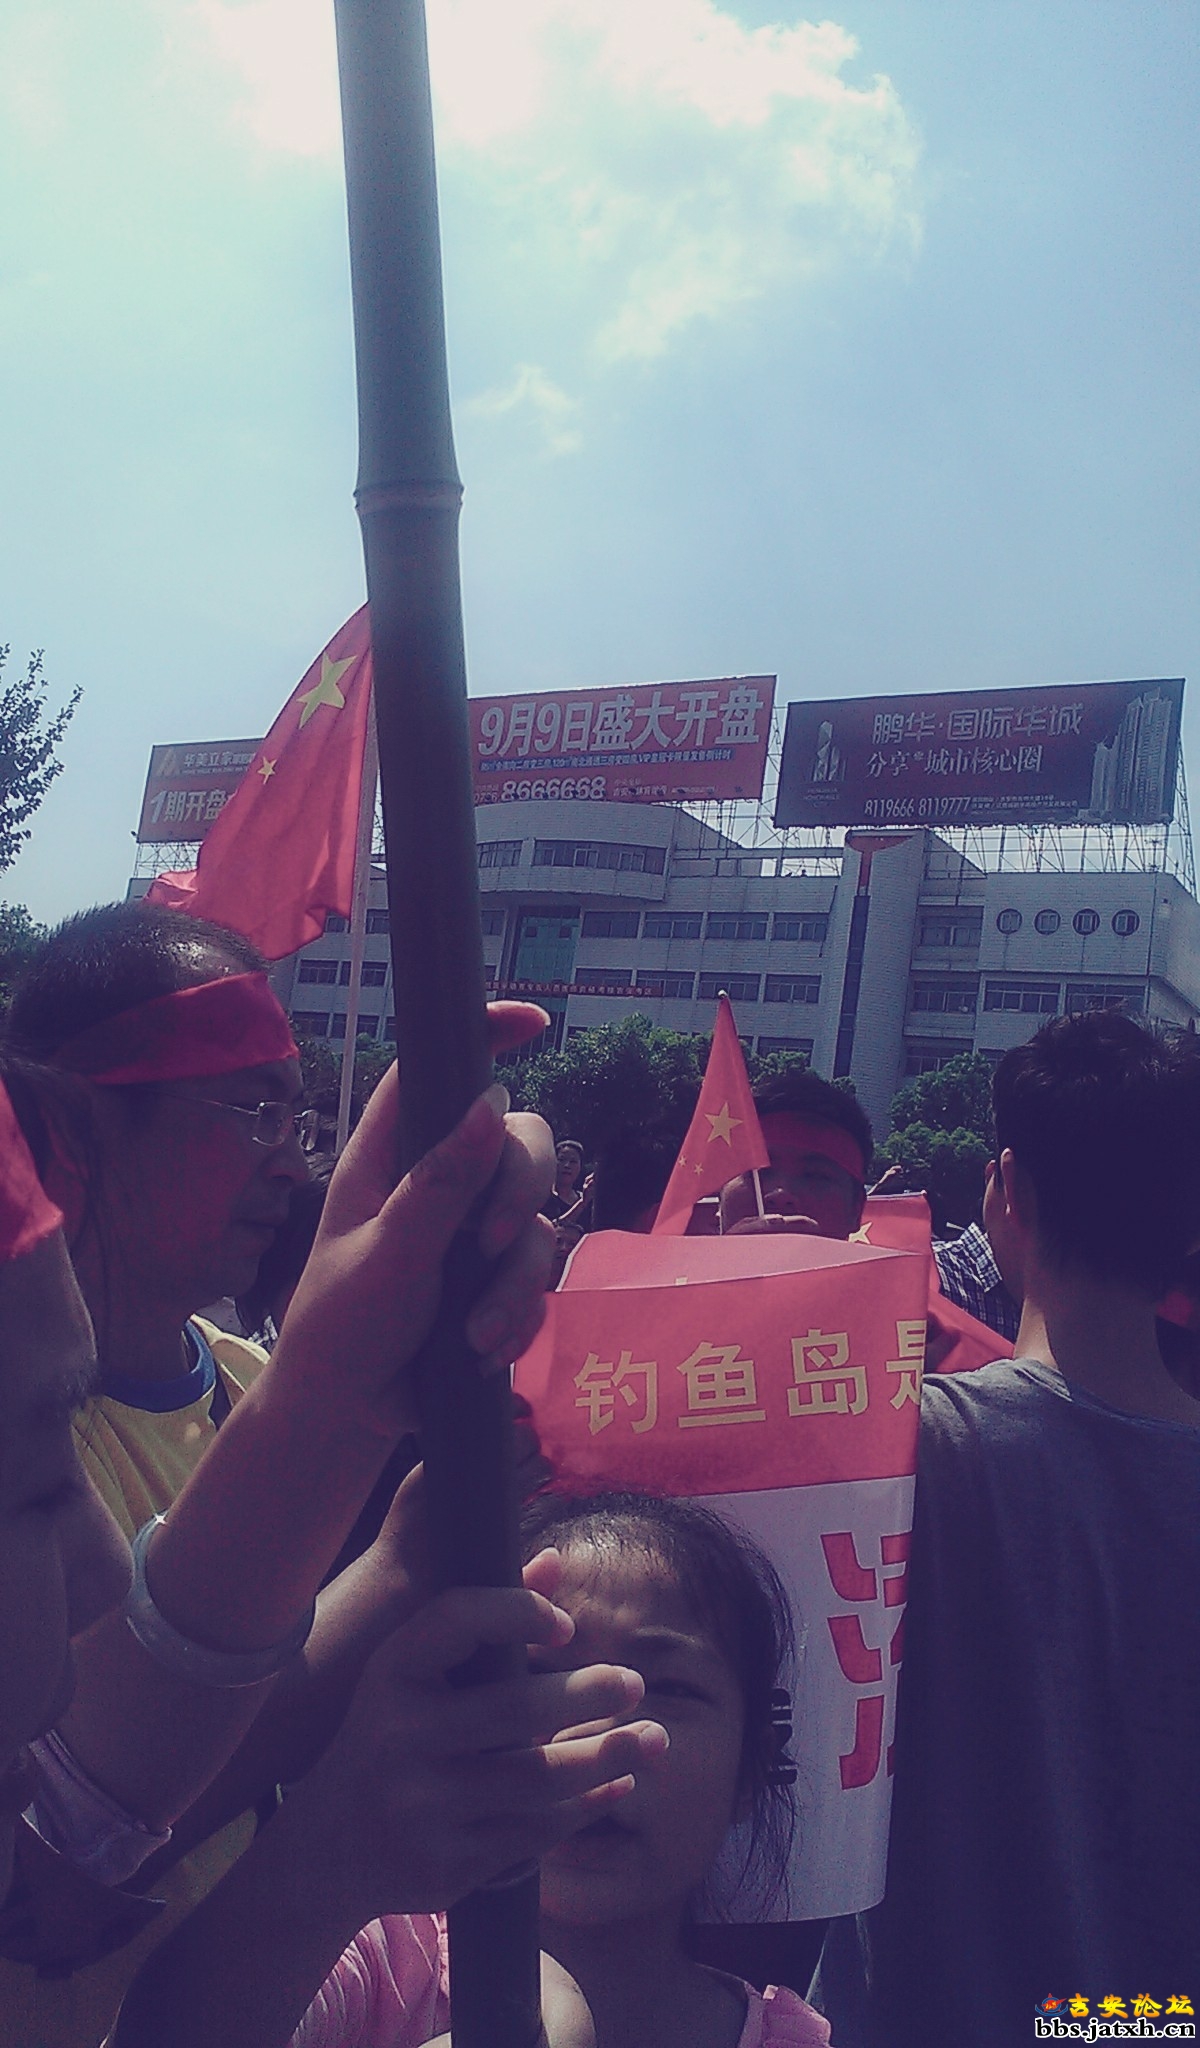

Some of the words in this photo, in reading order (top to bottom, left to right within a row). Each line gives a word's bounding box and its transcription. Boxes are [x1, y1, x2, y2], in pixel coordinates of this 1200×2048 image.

[478, 685, 764, 757] 9月9日盛大开盘
[501, 776, 607, 801] 8666668
[864, 798, 914, 817] 8119666
[918, 796, 971, 817] 8119777
